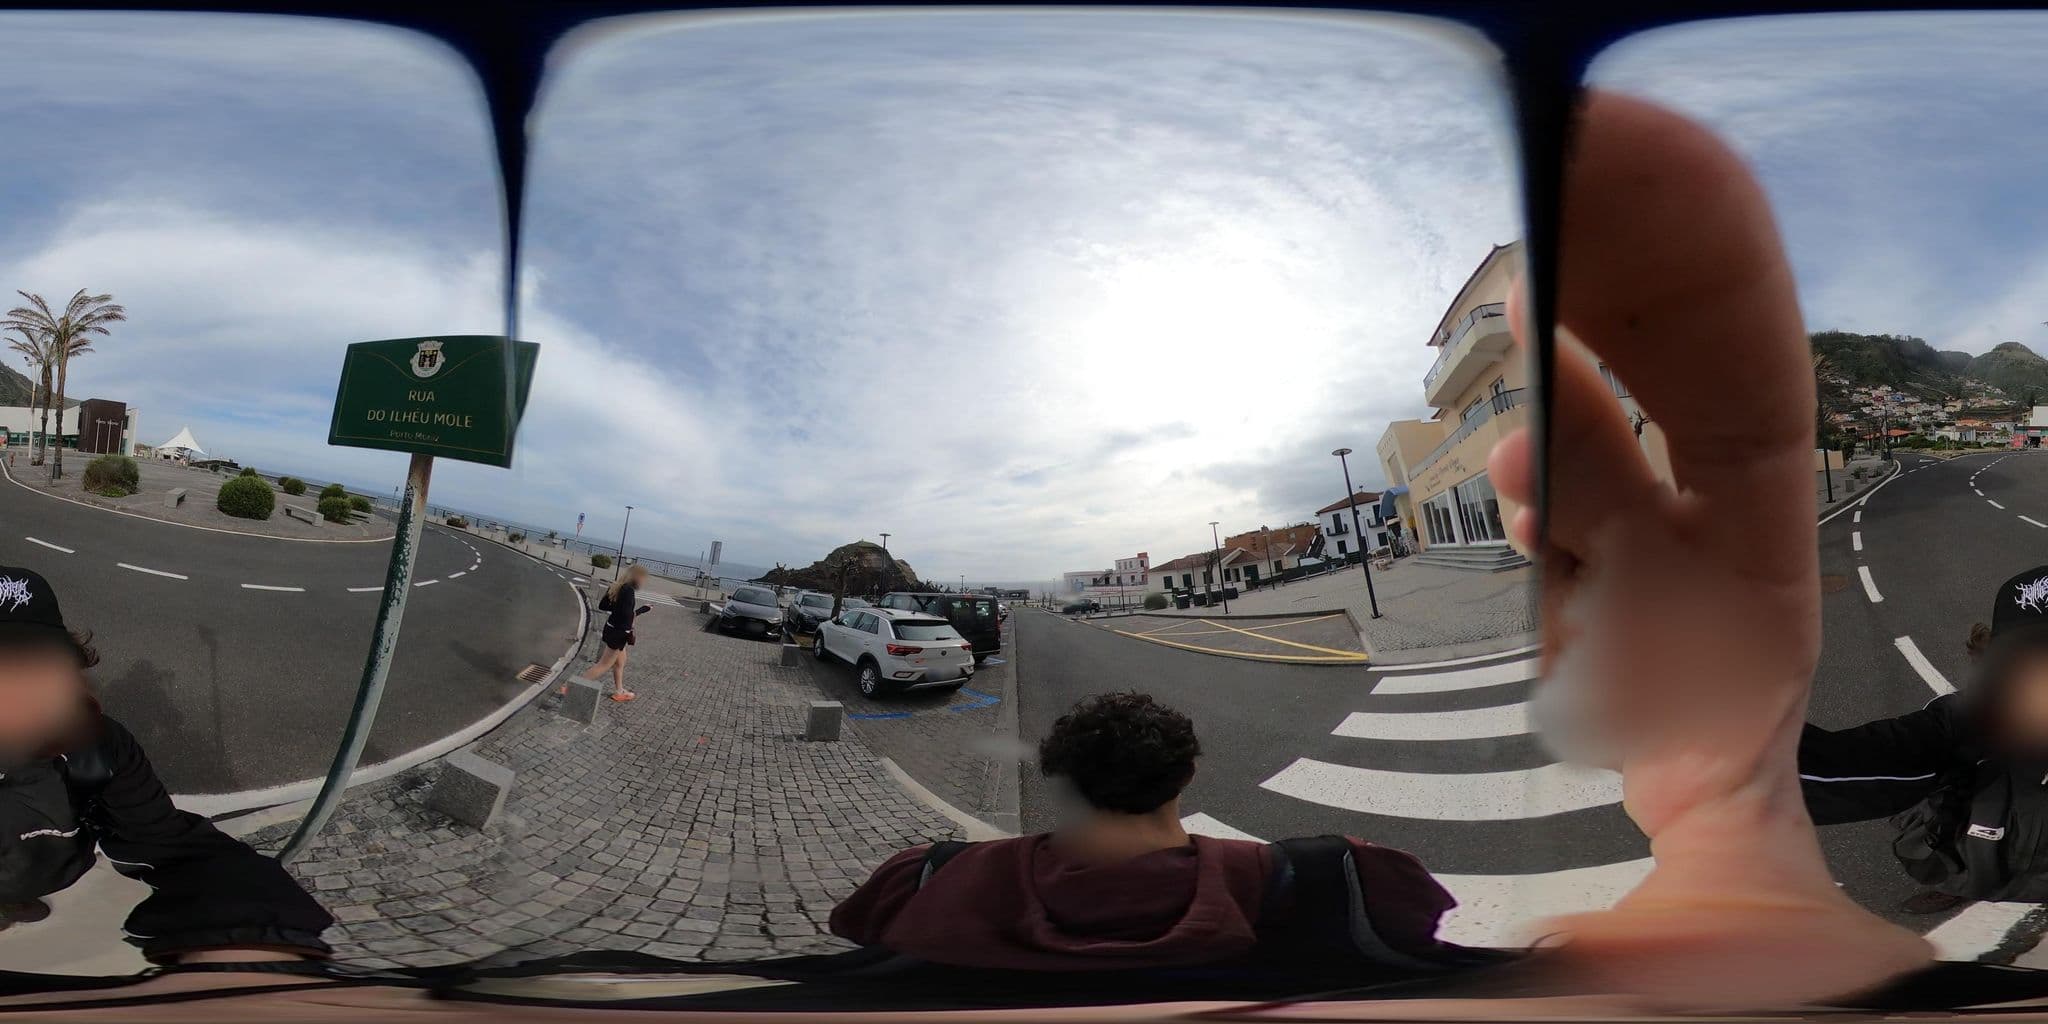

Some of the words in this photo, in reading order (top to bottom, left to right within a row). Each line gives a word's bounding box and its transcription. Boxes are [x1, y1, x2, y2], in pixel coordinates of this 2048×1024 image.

[408, 390, 435, 402] RUA
[367, 409, 386, 421] DO
[390, 407, 430, 424] ILHÉU
[434, 413, 473, 428] MOLE
[390, 429, 413, 439] Porto
